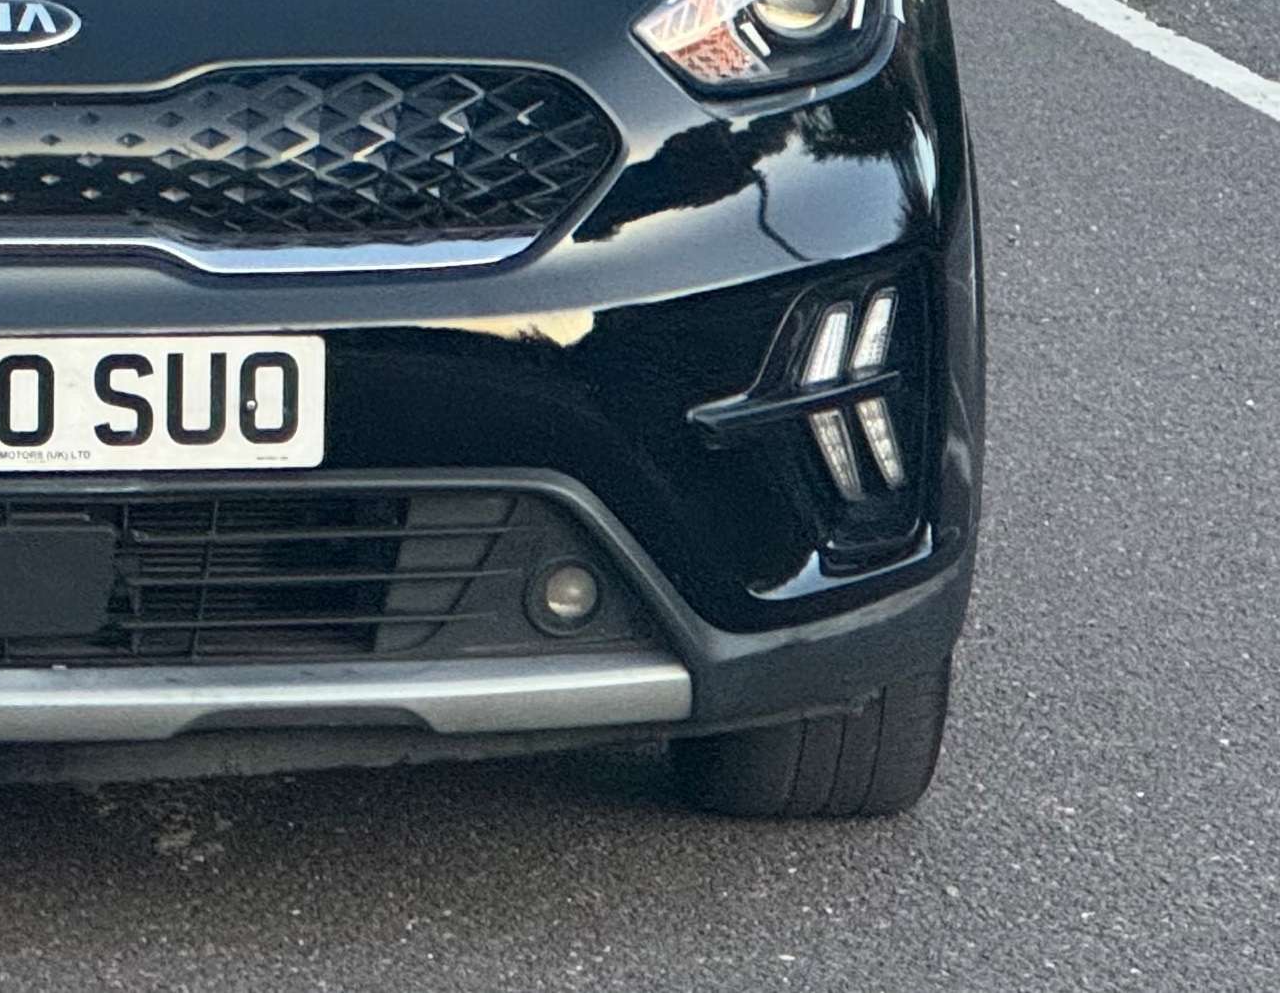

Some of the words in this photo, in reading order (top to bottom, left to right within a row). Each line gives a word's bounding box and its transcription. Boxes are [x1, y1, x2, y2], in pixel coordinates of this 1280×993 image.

[93, 352, 299, 448] SUO
[0, 451, 43, 460] MOTORS
[47, 450, 68, 461] (UK)
[71, 450, 91, 459] LTD
